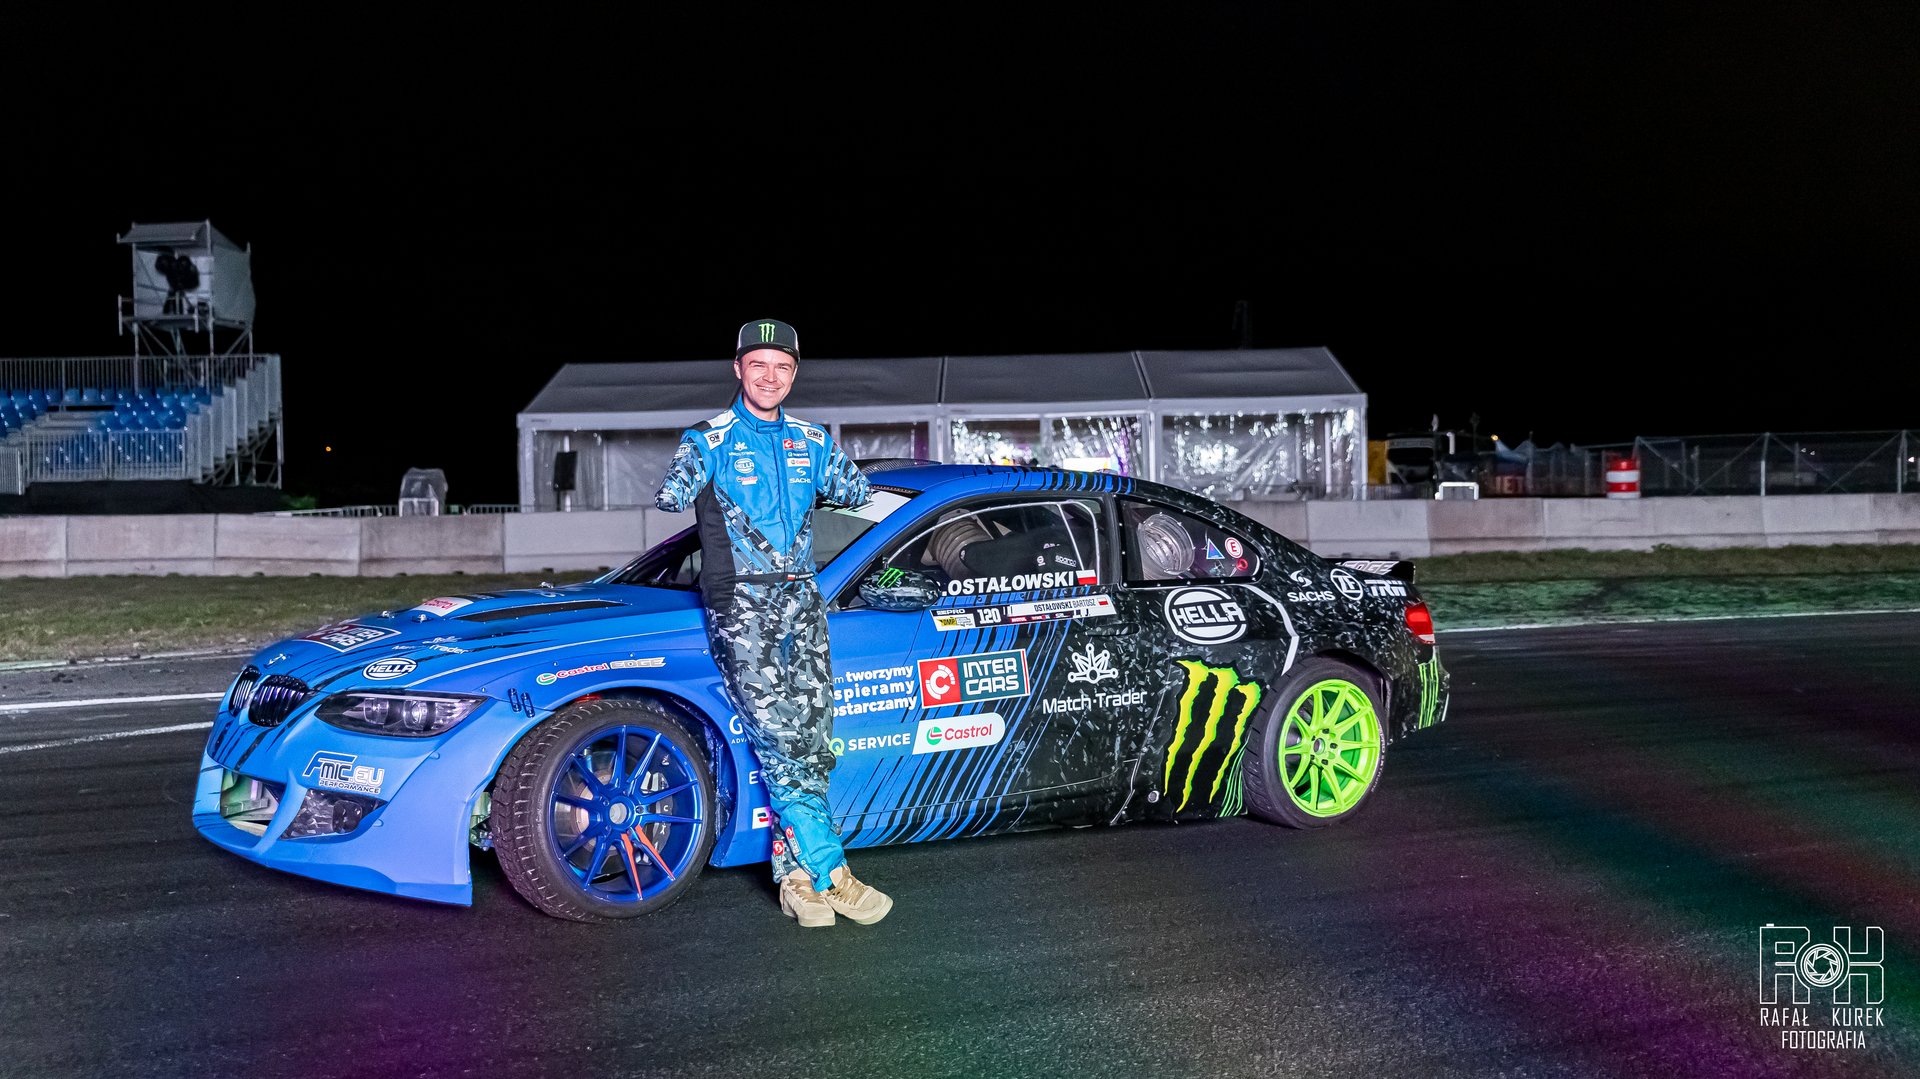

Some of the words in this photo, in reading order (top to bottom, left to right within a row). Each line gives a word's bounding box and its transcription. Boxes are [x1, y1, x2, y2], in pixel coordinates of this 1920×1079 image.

[937, 570, 1074, 597] .OSTAŁOWSKI
[1332, 573, 1362, 595] ZF
[1033, 601, 1073, 612] OSTAŁOWSKI
[1073, 598, 1096, 609] BARTOSZ
[1286, 590, 1336, 602] SACHS
[977, 607, 1002, 625] 120
[1171, 601, 1246, 627] HELLA
[368, 663, 418, 674] HELLA
[557, 662, 610, 678] Castrol
[610, 657, 666, 669] EDGE
[845, 665, 914, 682] tworzymy
[962, 657, 1018, 678] INTER
[965, 675, 1020, 696] CARS
[944, 723, 993, 741] Castrol
[848, 733, 911, 751] SERVICE
[319, 779, 381, 795] PERFORMANCE
